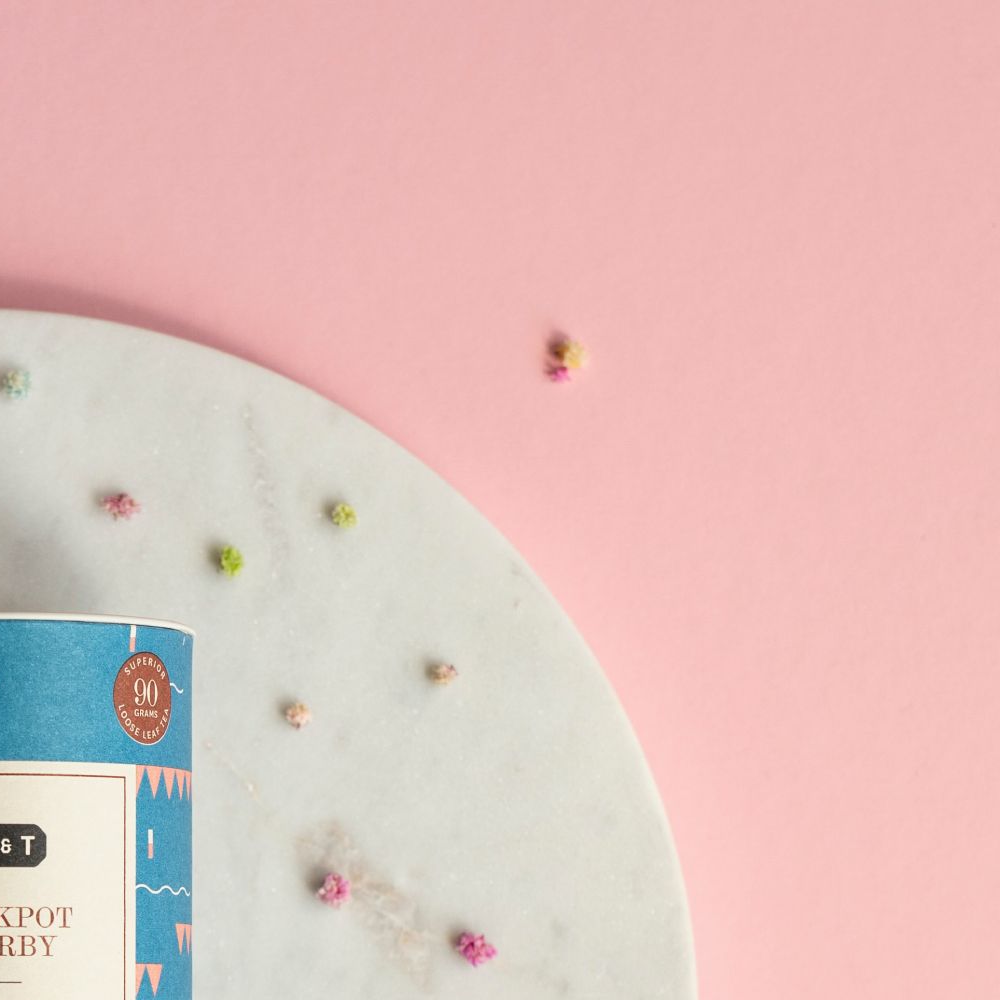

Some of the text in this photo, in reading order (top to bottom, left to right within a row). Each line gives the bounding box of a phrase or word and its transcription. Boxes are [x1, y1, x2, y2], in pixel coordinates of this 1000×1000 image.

[124, 657, 166, 680] SUPERIOR
[134, 678, 158, 707] 90
[118, 704, 169, 739] LOOSE LEAF TEA
[134, 708, 158, 719] GRAMS
